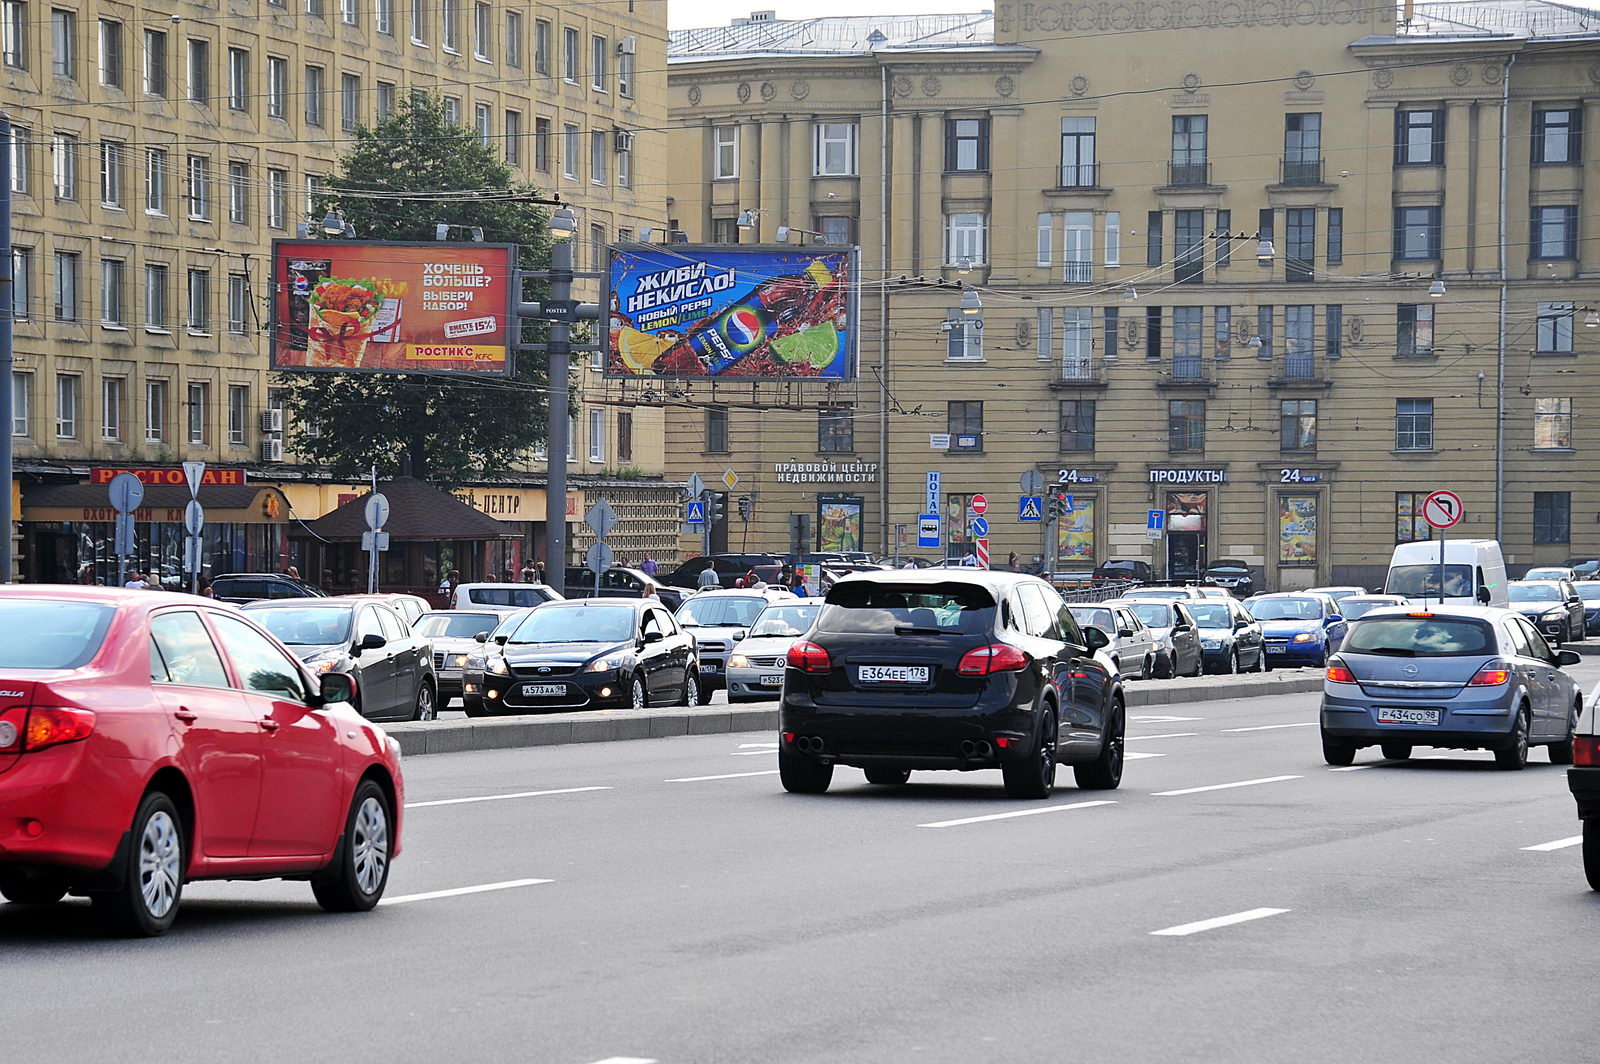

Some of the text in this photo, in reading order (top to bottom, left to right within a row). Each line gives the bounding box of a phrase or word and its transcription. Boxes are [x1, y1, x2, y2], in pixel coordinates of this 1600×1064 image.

[423, 263, 484, 275] ХОЧЕШЬ
[423, 275, 492, 288] БОЛЬШЕ?
[636, 261, 706, 294] ЖИВИ
[423, 291, 474, 302] ВЫБЕРИ
[628, 267, 736, 313] НЕКИСЛО!
[423, 302, 468, 311] НАБОР!
[637, 298, 712, 323] НОВЫЙ PEPSI
[475, 319, 493, 331] 15%
[474, 353, 493, 361] KFC
[775, 462, 877, 473] ПРАВОВОЙ ЦЕНТР
[100, 469, 236, 484] РСТОАН
[777, 473, 875, 483] НЕДВИЖИМОСТИ
[1059, 469, 1078, 483] 24
[1150, 470, 1223, 484] ПРОДУКТЫ
[1280, 468, 1300, 483] 24
[929, 473, 938, 514] НОТА
[862, 667, 906, 680] Е364ЕЕ
[909, 667, 926, 677] 178
[525, 686, 555, 694] А573АА
[1382, 709, 1436, 721] Р434СО 98
